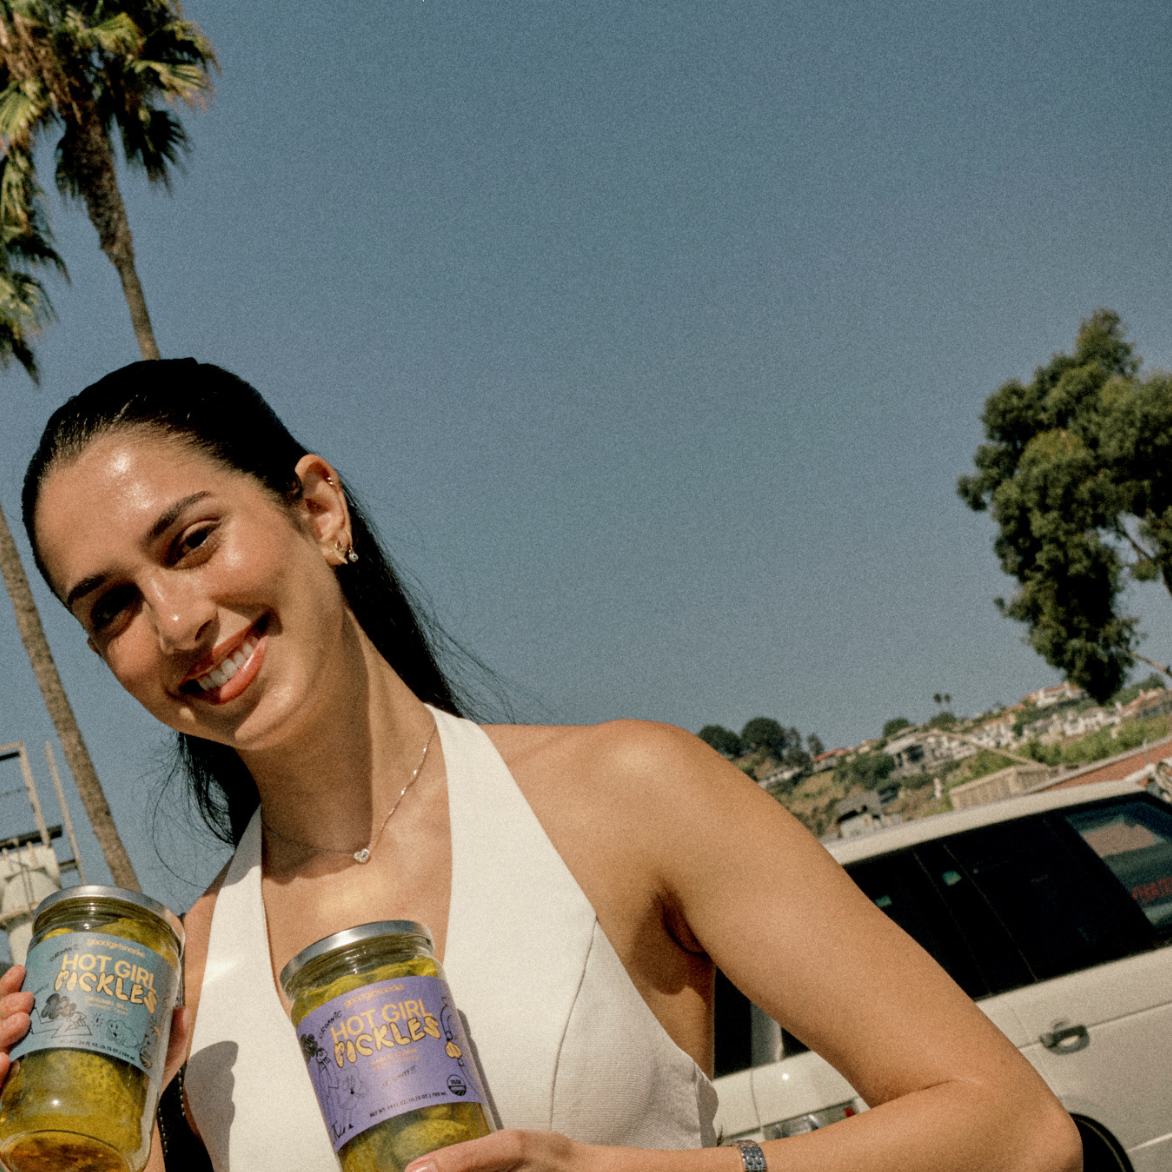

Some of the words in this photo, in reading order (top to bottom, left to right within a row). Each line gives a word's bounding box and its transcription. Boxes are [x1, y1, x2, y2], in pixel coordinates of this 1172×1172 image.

[54, 970, 159, 1015] PICKLES
[61, 953, 112, 973] HOT
[114, 960, 157, 995] GIRL
[330, 1008, 376, 1044] HOT
[381, 999, 433, 1023] GIRL
[334, 1016, 441, 1068] PICKLES
